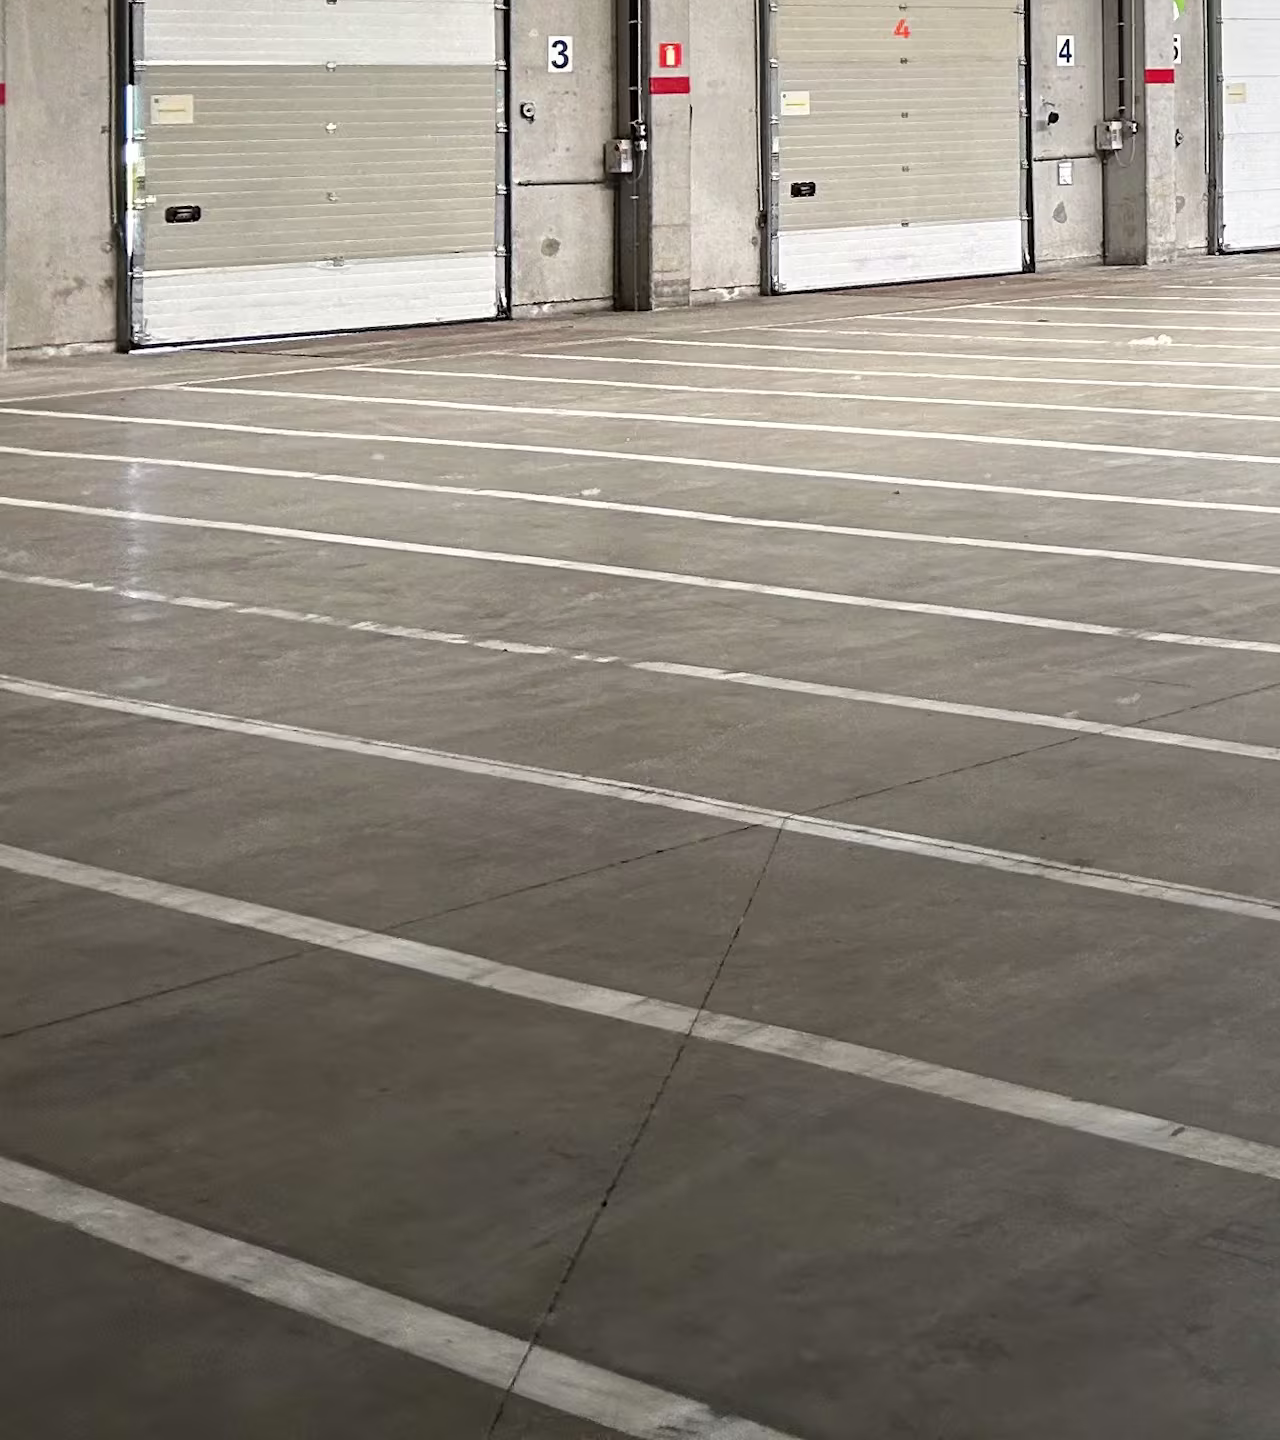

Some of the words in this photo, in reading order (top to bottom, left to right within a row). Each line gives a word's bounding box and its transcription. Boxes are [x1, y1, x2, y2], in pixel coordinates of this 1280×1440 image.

[893, 18, 911, 39] 4
[551, 39, 569, 69] 3
[1058, 38, 1073, 63] 4
